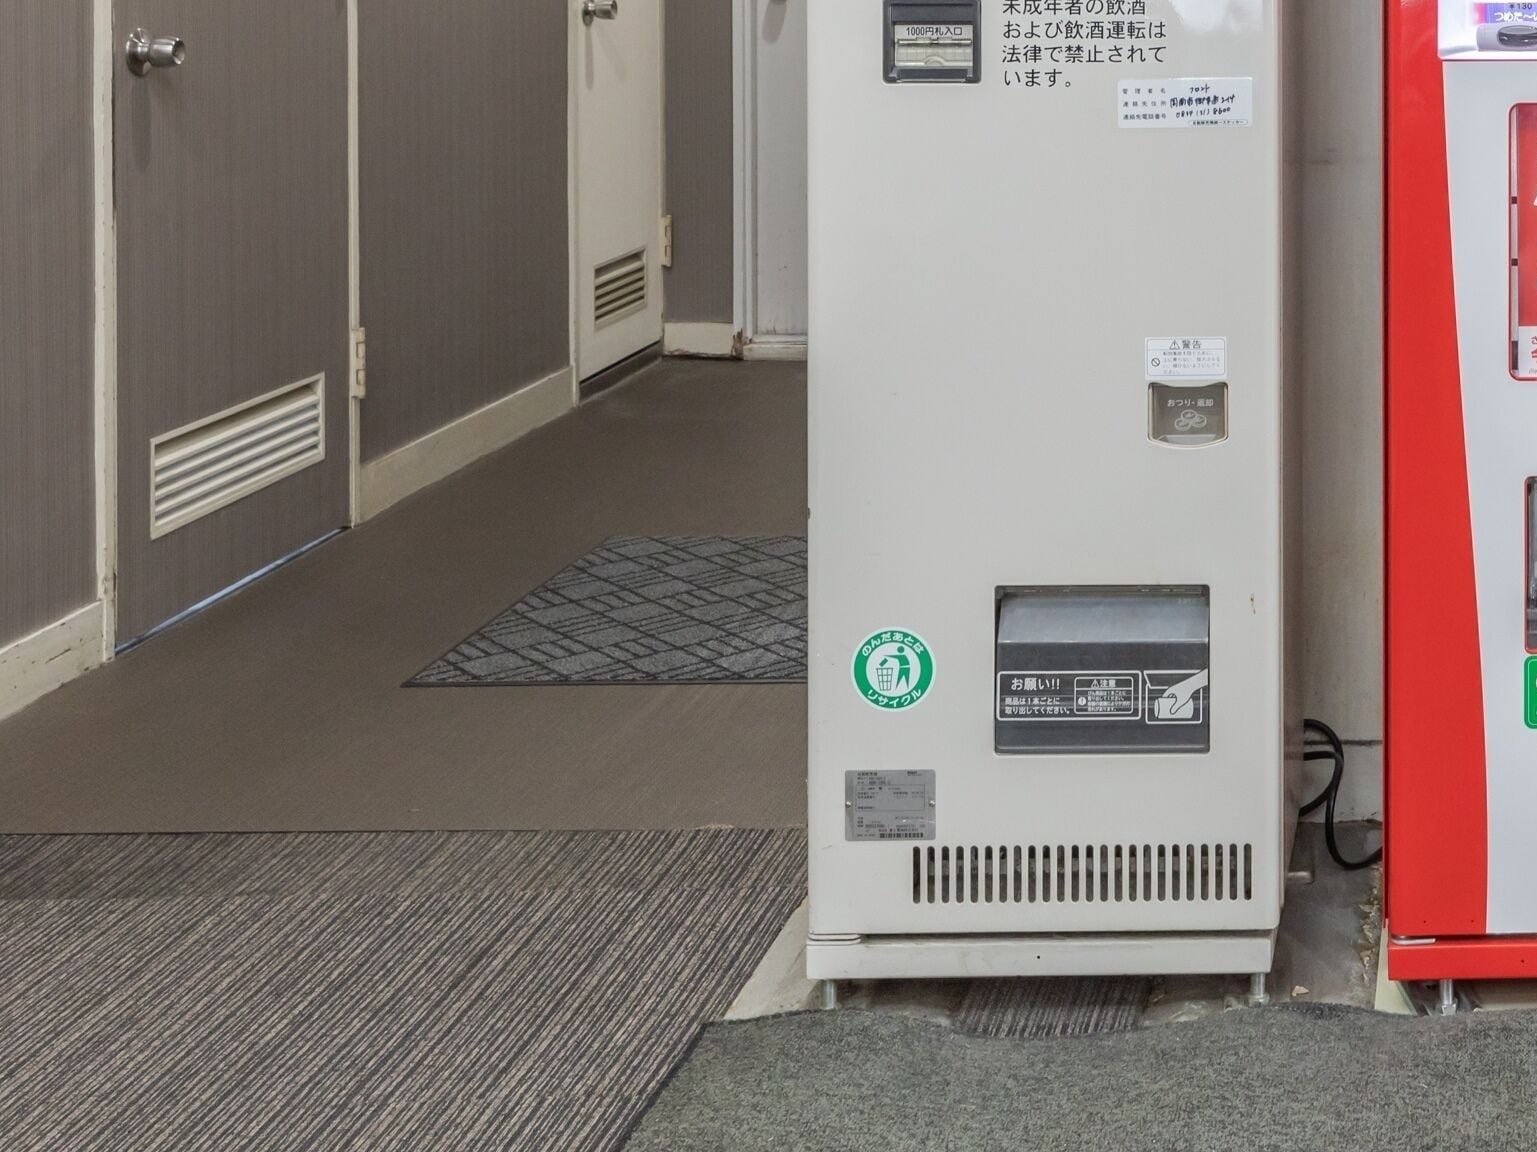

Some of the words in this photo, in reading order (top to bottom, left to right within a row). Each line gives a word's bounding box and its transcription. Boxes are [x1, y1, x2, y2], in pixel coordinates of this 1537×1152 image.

[906, 26, 963, 37] 1000円札入口
[1003, 21, 1167, 39] および飲酒運転は
[1002, 45, 1167, 64] 法律で禁止されて
[1004, 69, 1073, 88] います。
[1182, 340, 1202, 349] 警告
[862, 632, 925, 657] のんだあとは
[1011, 678, 1060, 691] お願い!!
[867, 688, 923, 708] リサイクル
[1005, 706, 1071, 715] 取り出してください。
